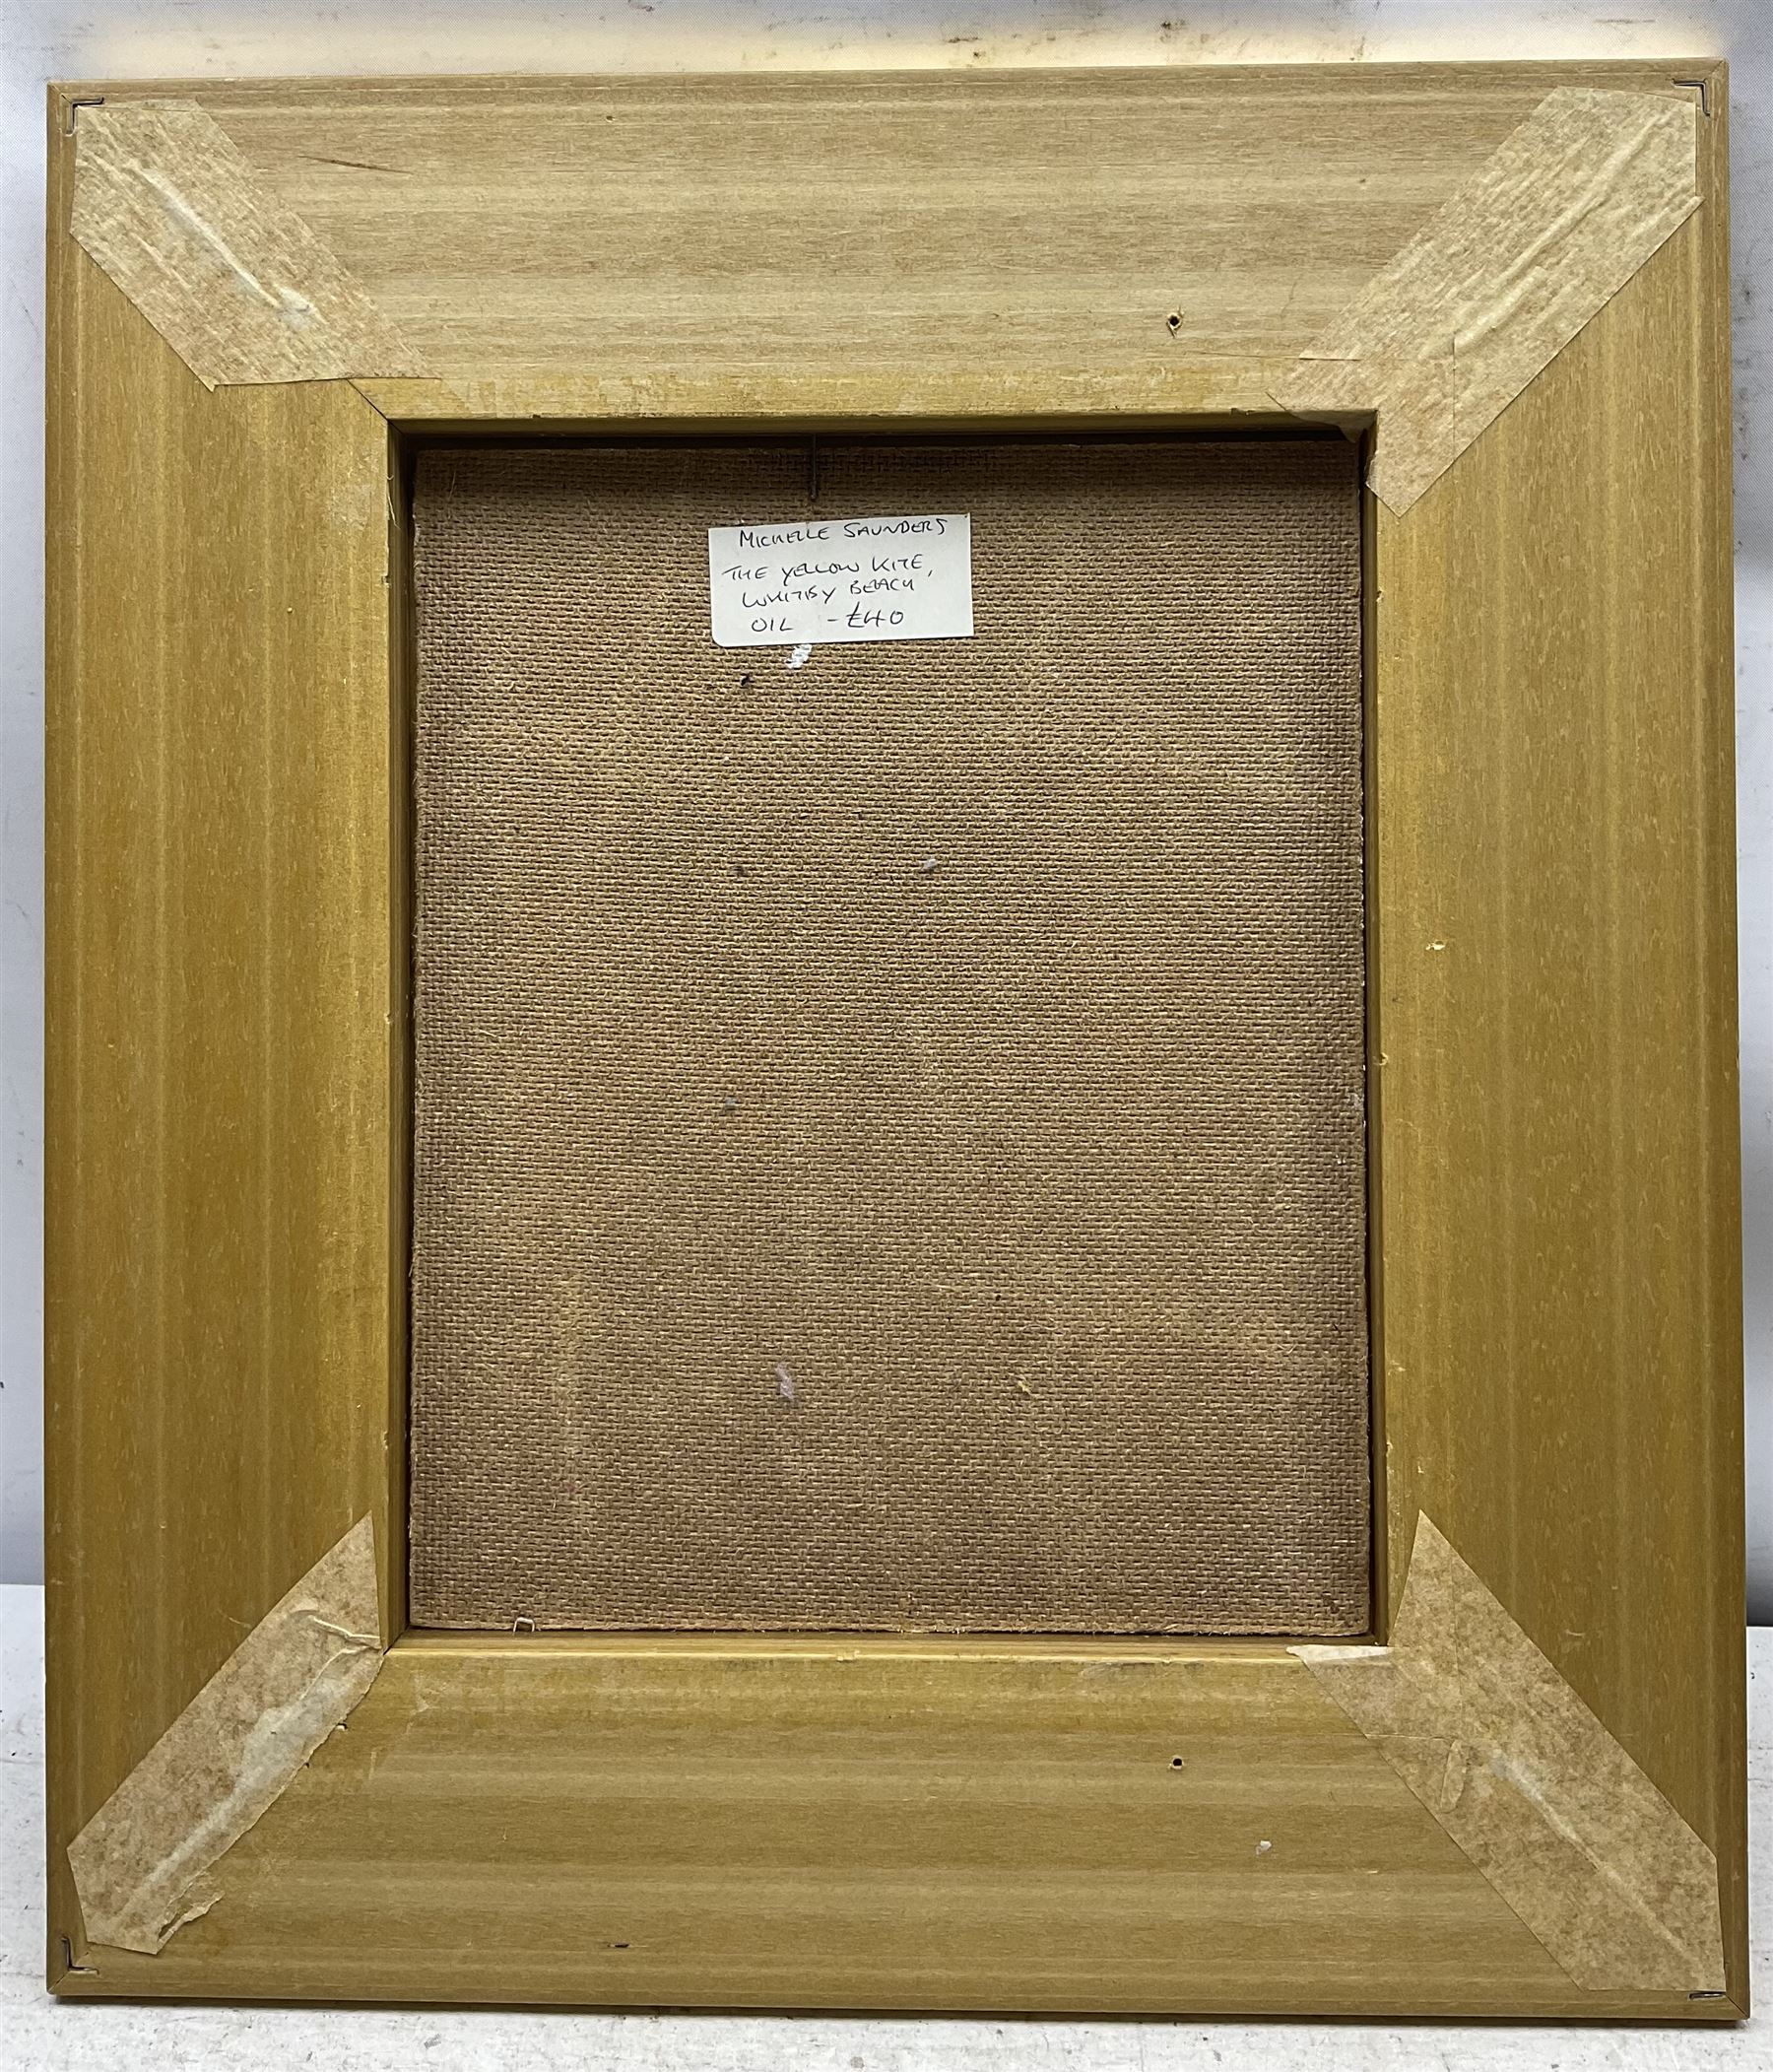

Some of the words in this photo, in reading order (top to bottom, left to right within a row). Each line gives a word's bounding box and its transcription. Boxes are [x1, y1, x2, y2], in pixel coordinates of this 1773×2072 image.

[739, 526, 830, 549] MICHELLE
[843, 518, 949, 539] SAUNDERS
[722, 565, 768, 580] THE
[781, 563, 860, 586] YELLOW
[872, 554, 934, 577] KITE,
[742, 585, 836, 608] WHITBY
[850, 578, 915, 595] BEACH
[751, 617, 794, 633] OIL
